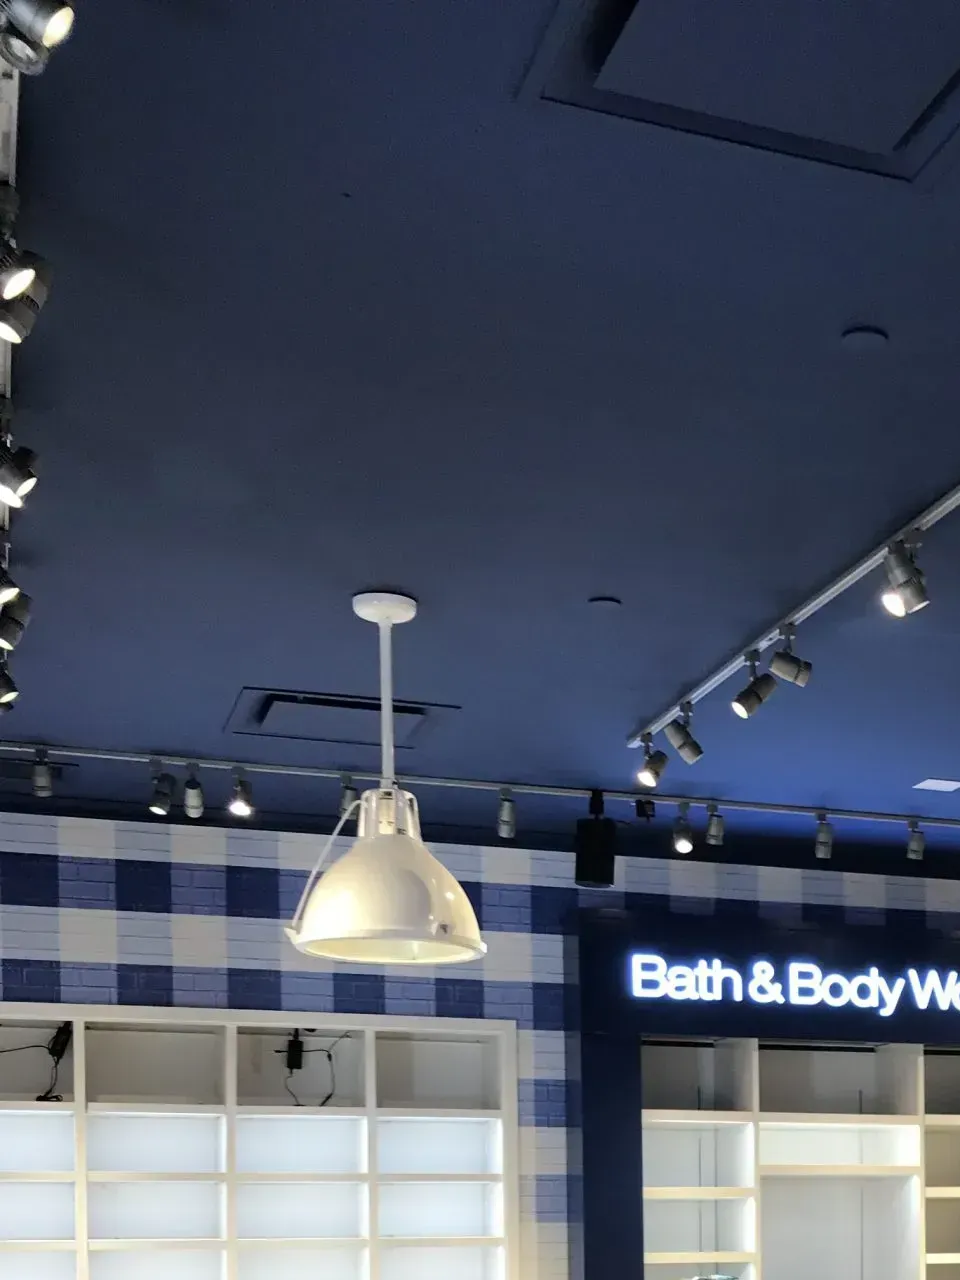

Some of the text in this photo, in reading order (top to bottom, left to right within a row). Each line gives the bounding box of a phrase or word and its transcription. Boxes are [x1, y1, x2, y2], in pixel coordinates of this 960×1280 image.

[630, 953, 743, 1001] Bath
[747, 961, 786, 1005] &
[788, 961, 904, 1017] Body
